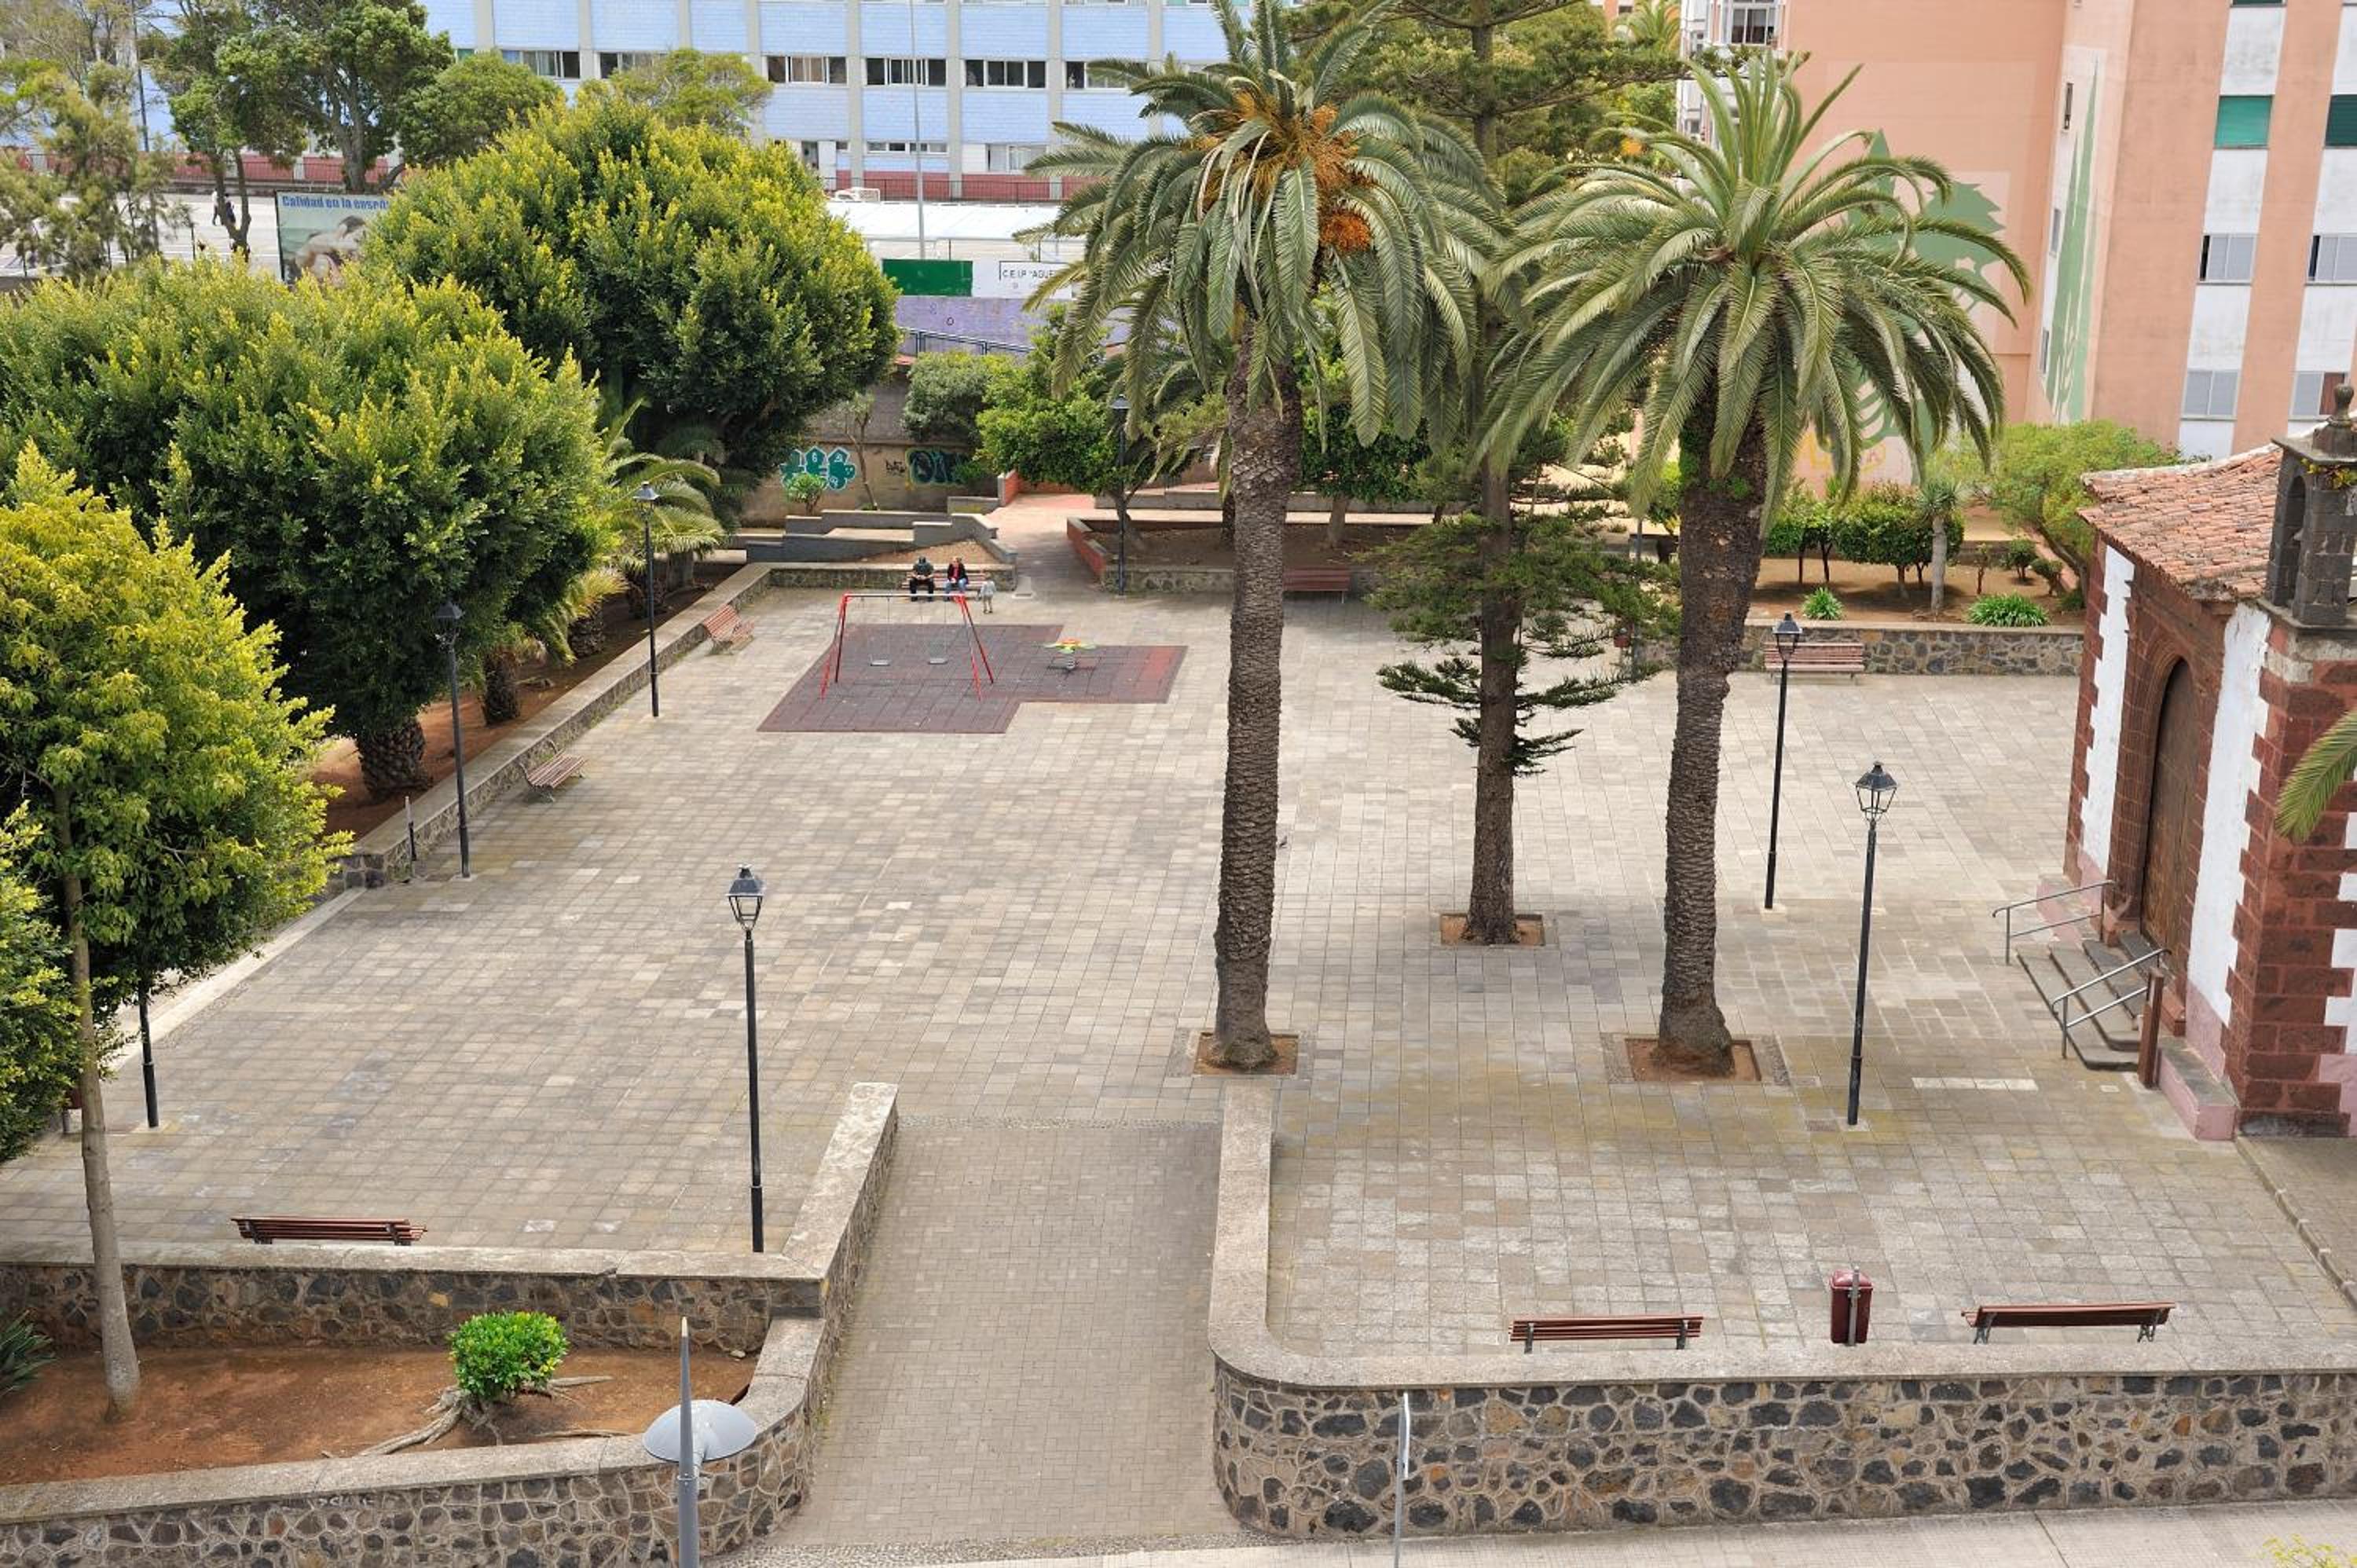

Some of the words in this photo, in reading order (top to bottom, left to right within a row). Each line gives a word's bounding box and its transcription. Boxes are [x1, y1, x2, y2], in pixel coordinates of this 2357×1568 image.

[282, 196, 324, 207] Calidad
[326, 198, 339, 208] en
[342, 197, 352, 208] la
